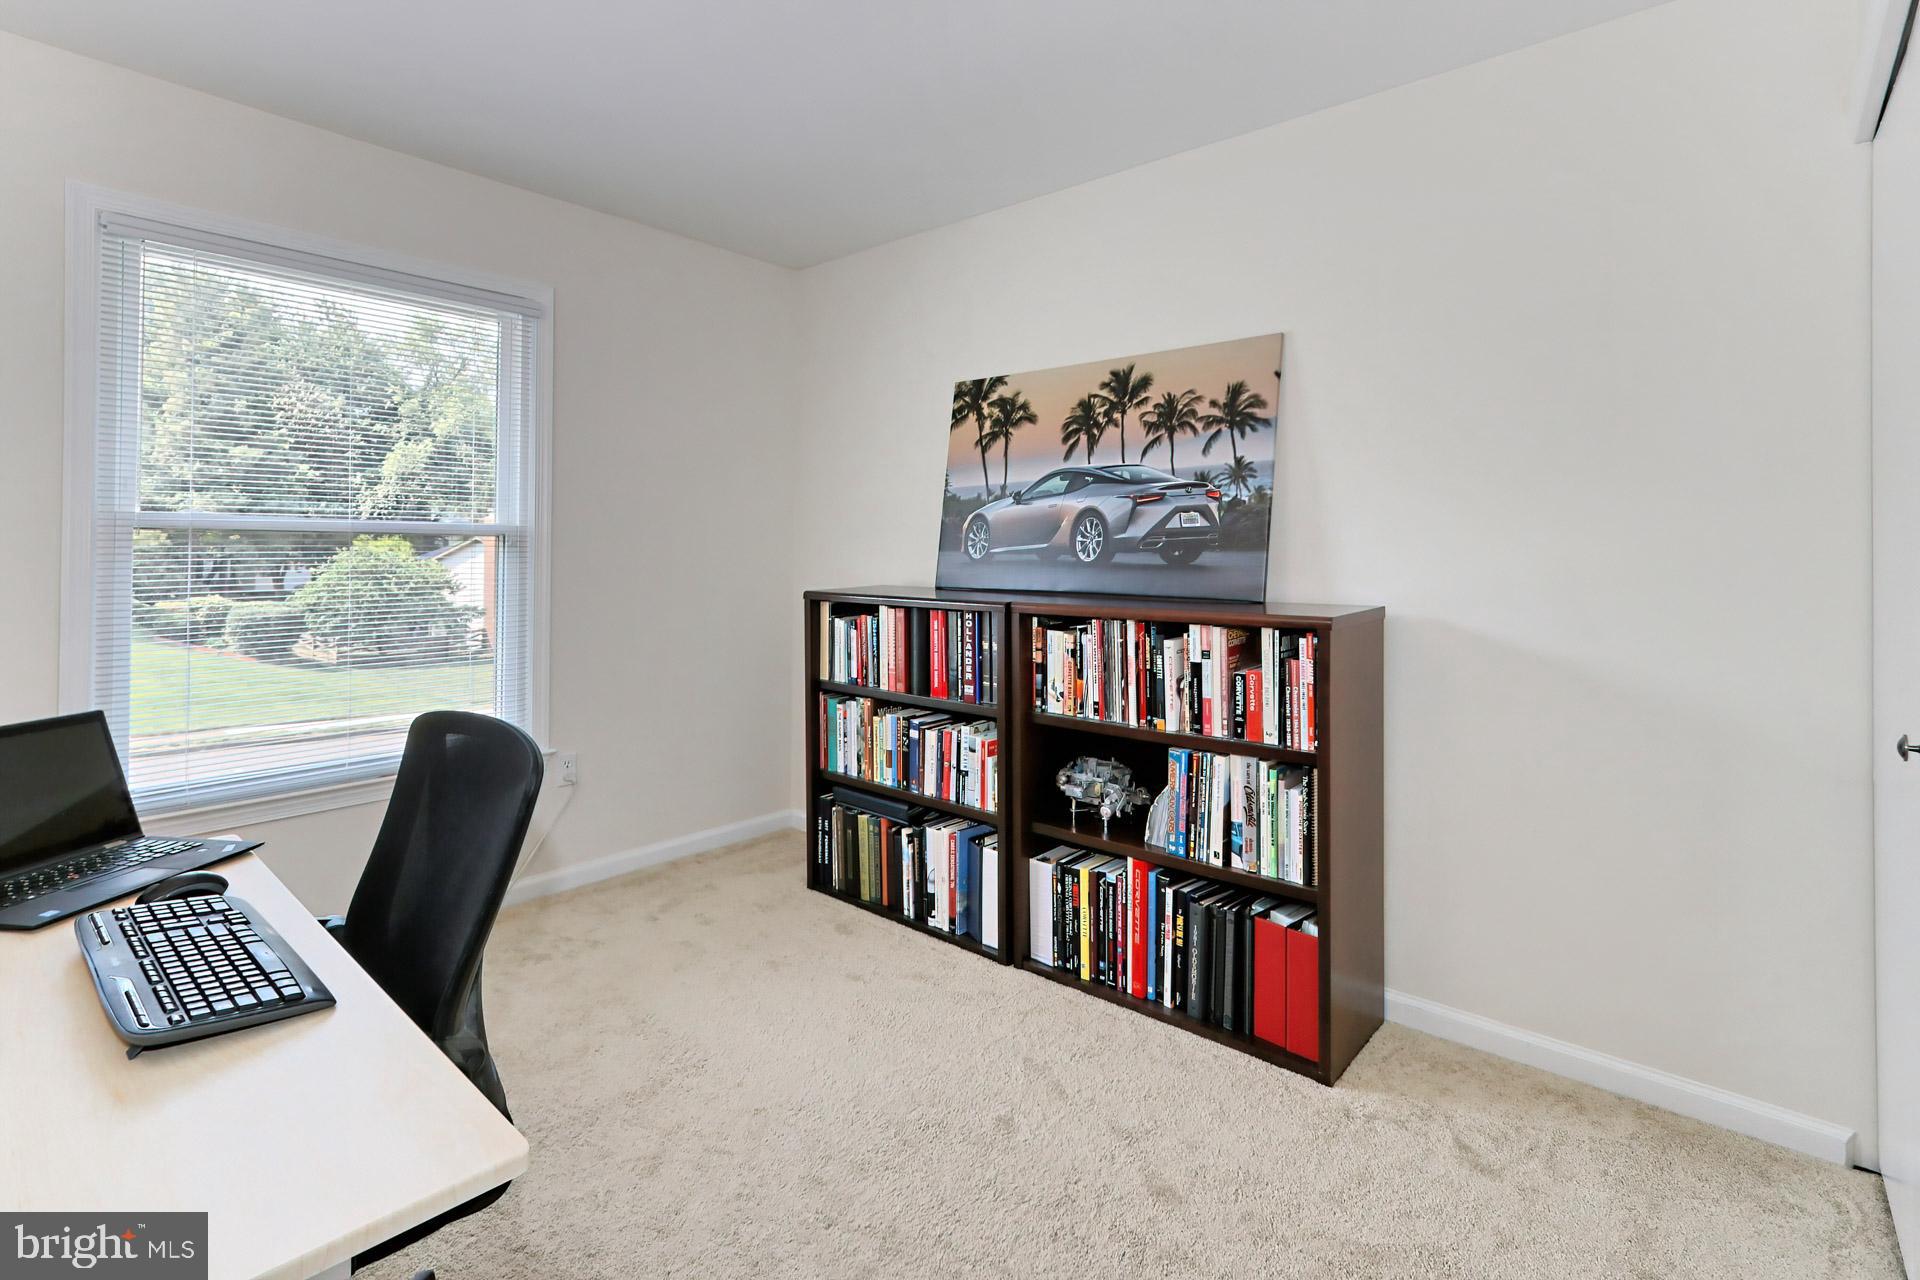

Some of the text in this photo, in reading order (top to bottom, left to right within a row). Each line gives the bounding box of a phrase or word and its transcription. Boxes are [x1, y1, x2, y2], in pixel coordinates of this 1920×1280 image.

[965, 612, 976, 681] HOLLANDER
[1169, 759, 1177, 810] AMERICAN
[1243, 785, 1257, 828] Oldsmobile
